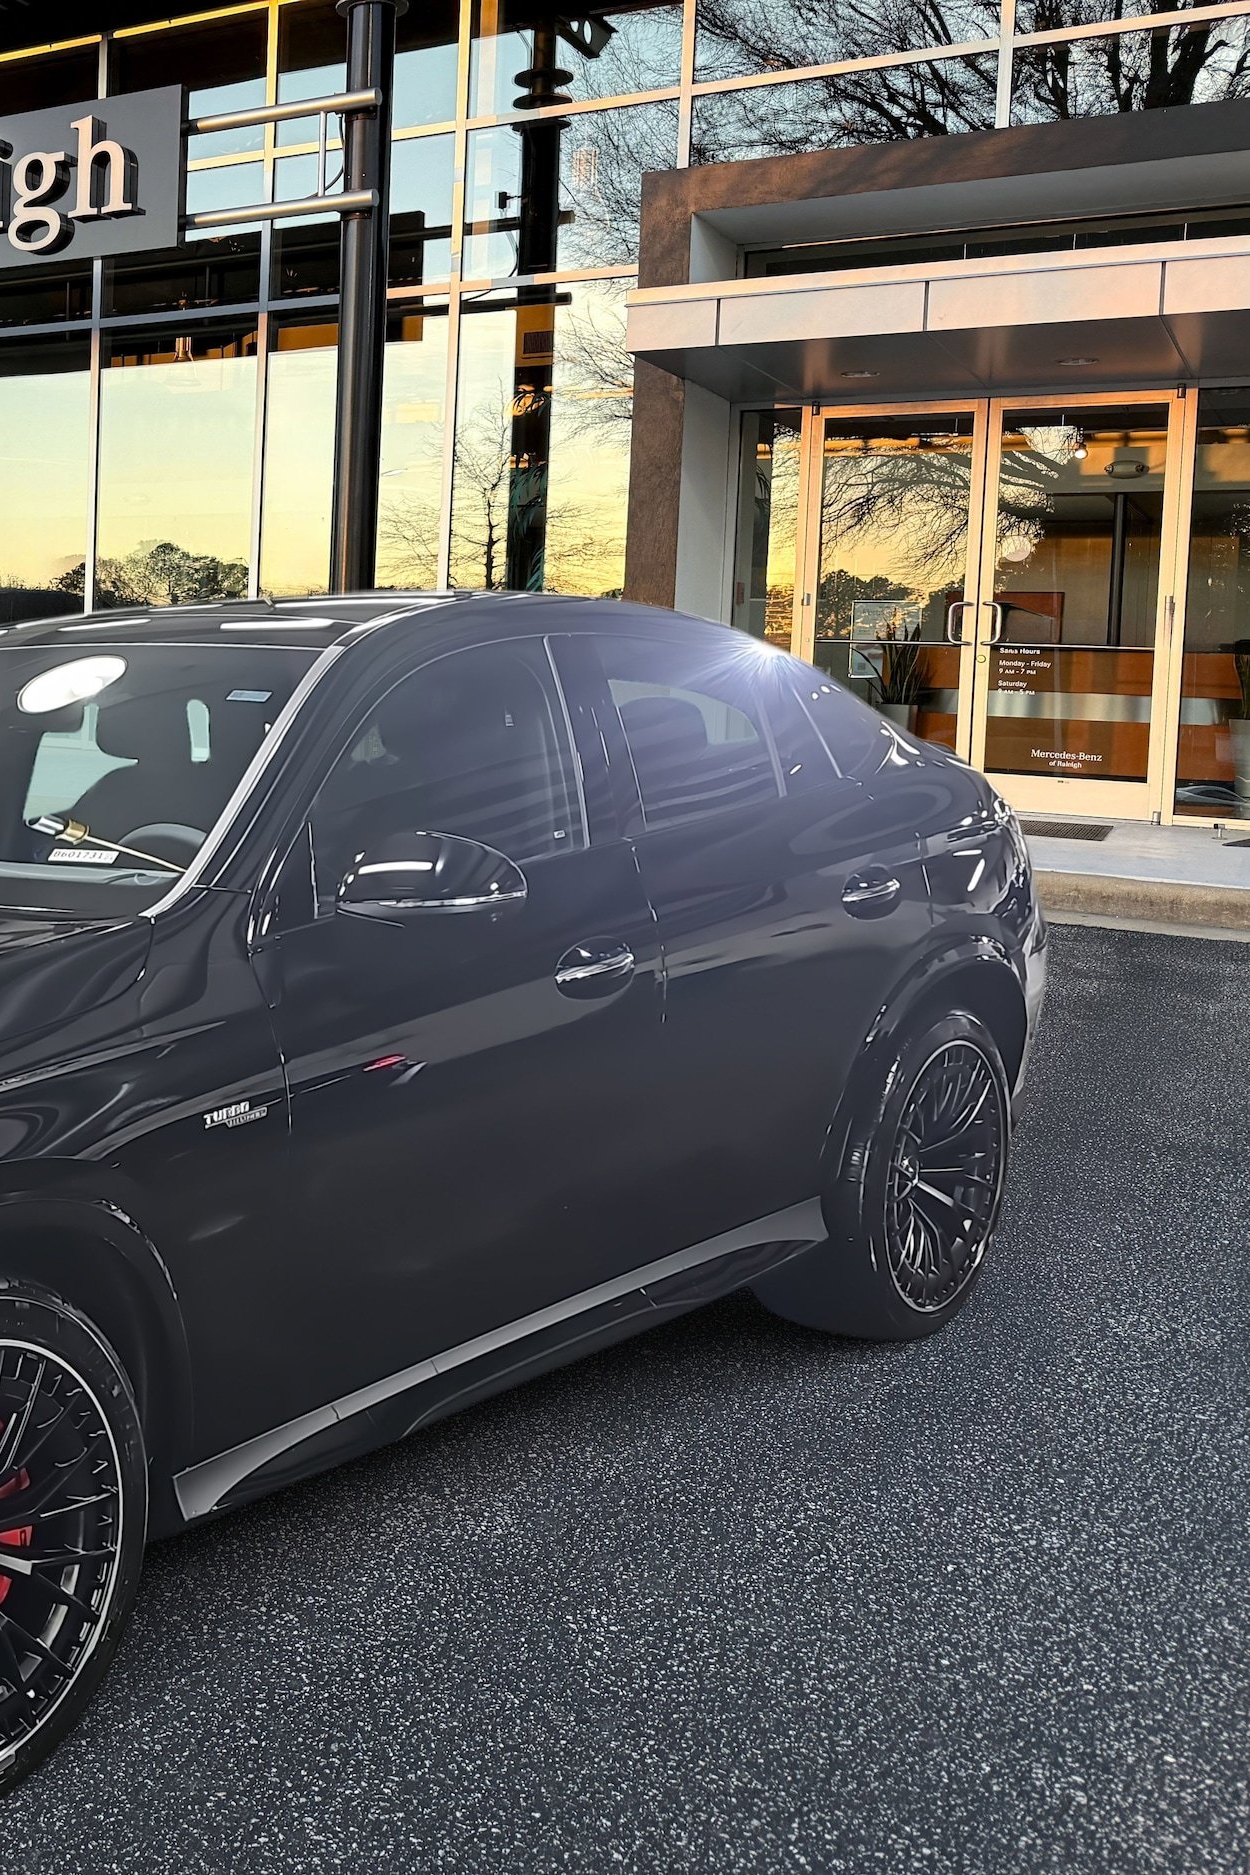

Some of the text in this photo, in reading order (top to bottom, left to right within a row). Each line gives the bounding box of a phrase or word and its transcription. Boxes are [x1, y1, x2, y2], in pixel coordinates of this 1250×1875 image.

[1030, 660, 1052, 669] Friday
[997, 680, 1028, 689] Saturday
[1031, 749, 1103, 761] Mercedes-Benz
[203, 1101, 249, 1125] TURBO
